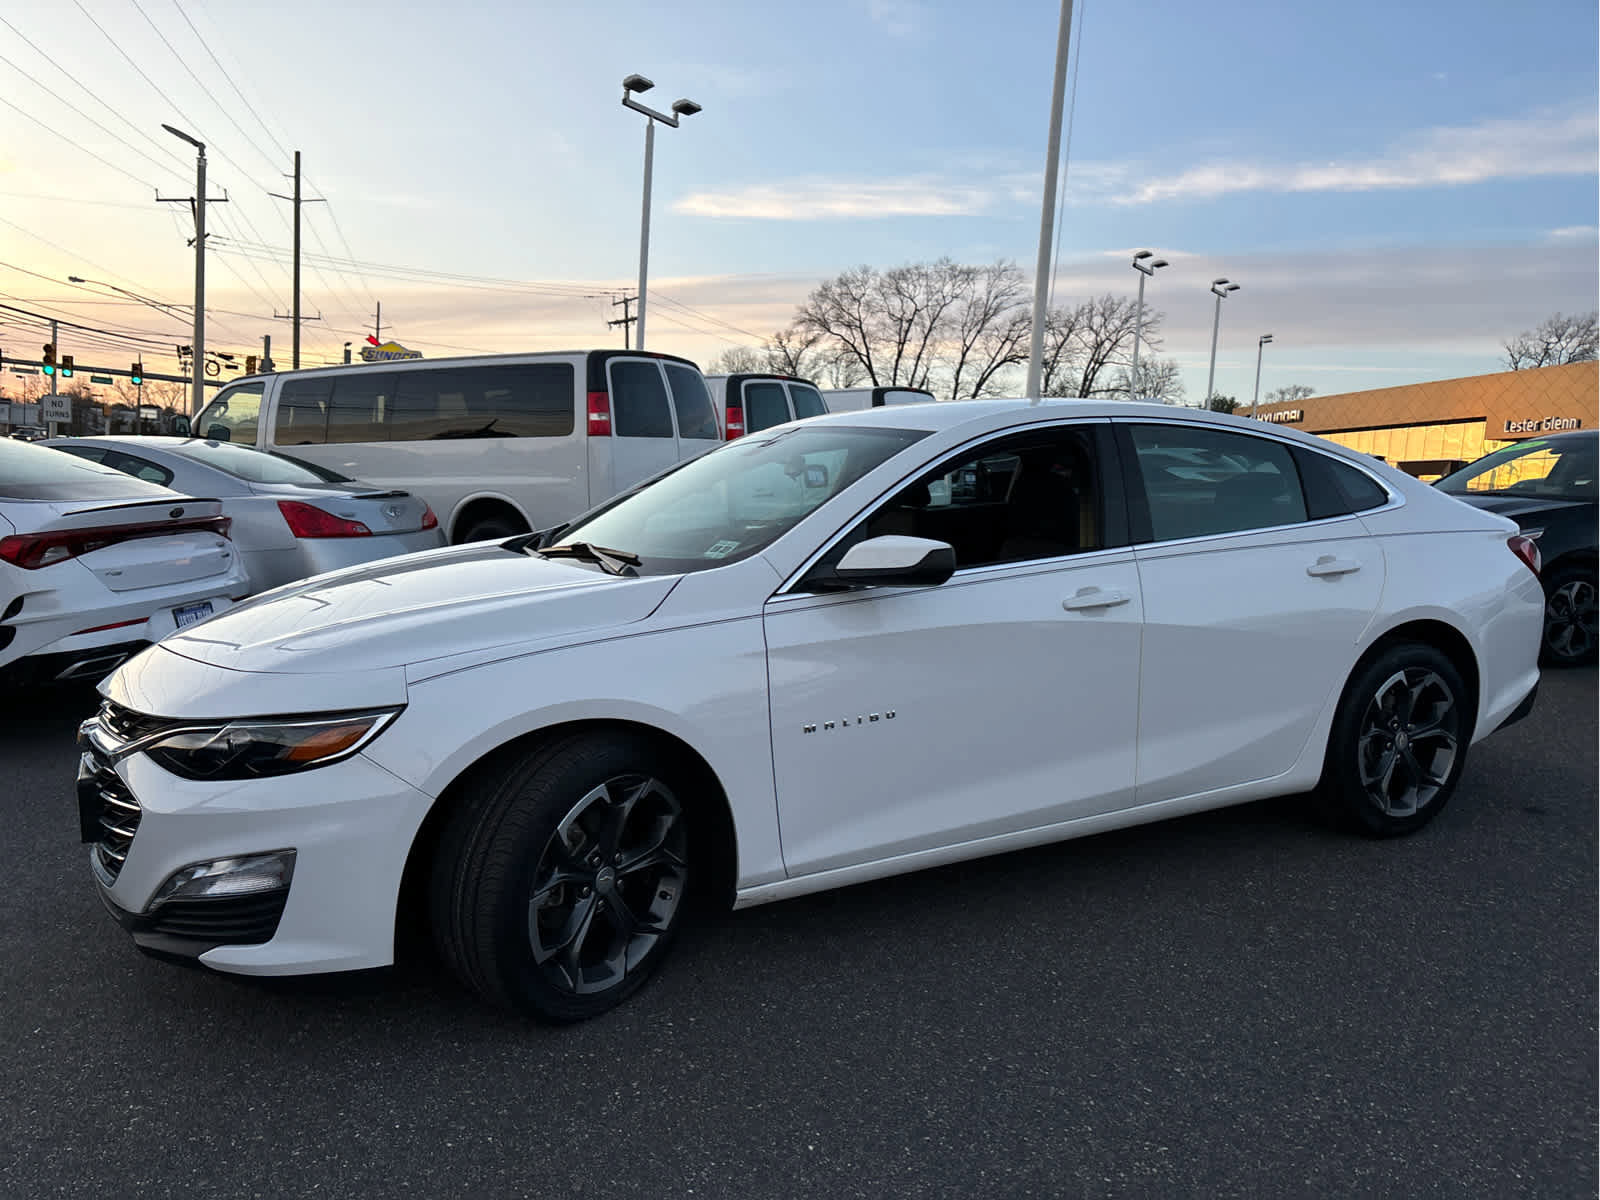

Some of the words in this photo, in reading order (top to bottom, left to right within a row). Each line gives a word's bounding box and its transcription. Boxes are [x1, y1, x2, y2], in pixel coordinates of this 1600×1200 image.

[365, 350, 419, 360] SUNOCO
[51, 400, 64, 408] NO
[45, 410, 70, 418] TURNS
[1503, 419, 1540, 433] Lester
[1542, 416, 1578, 431] Glenn
[803, 710, 896, 734] MALIBU
